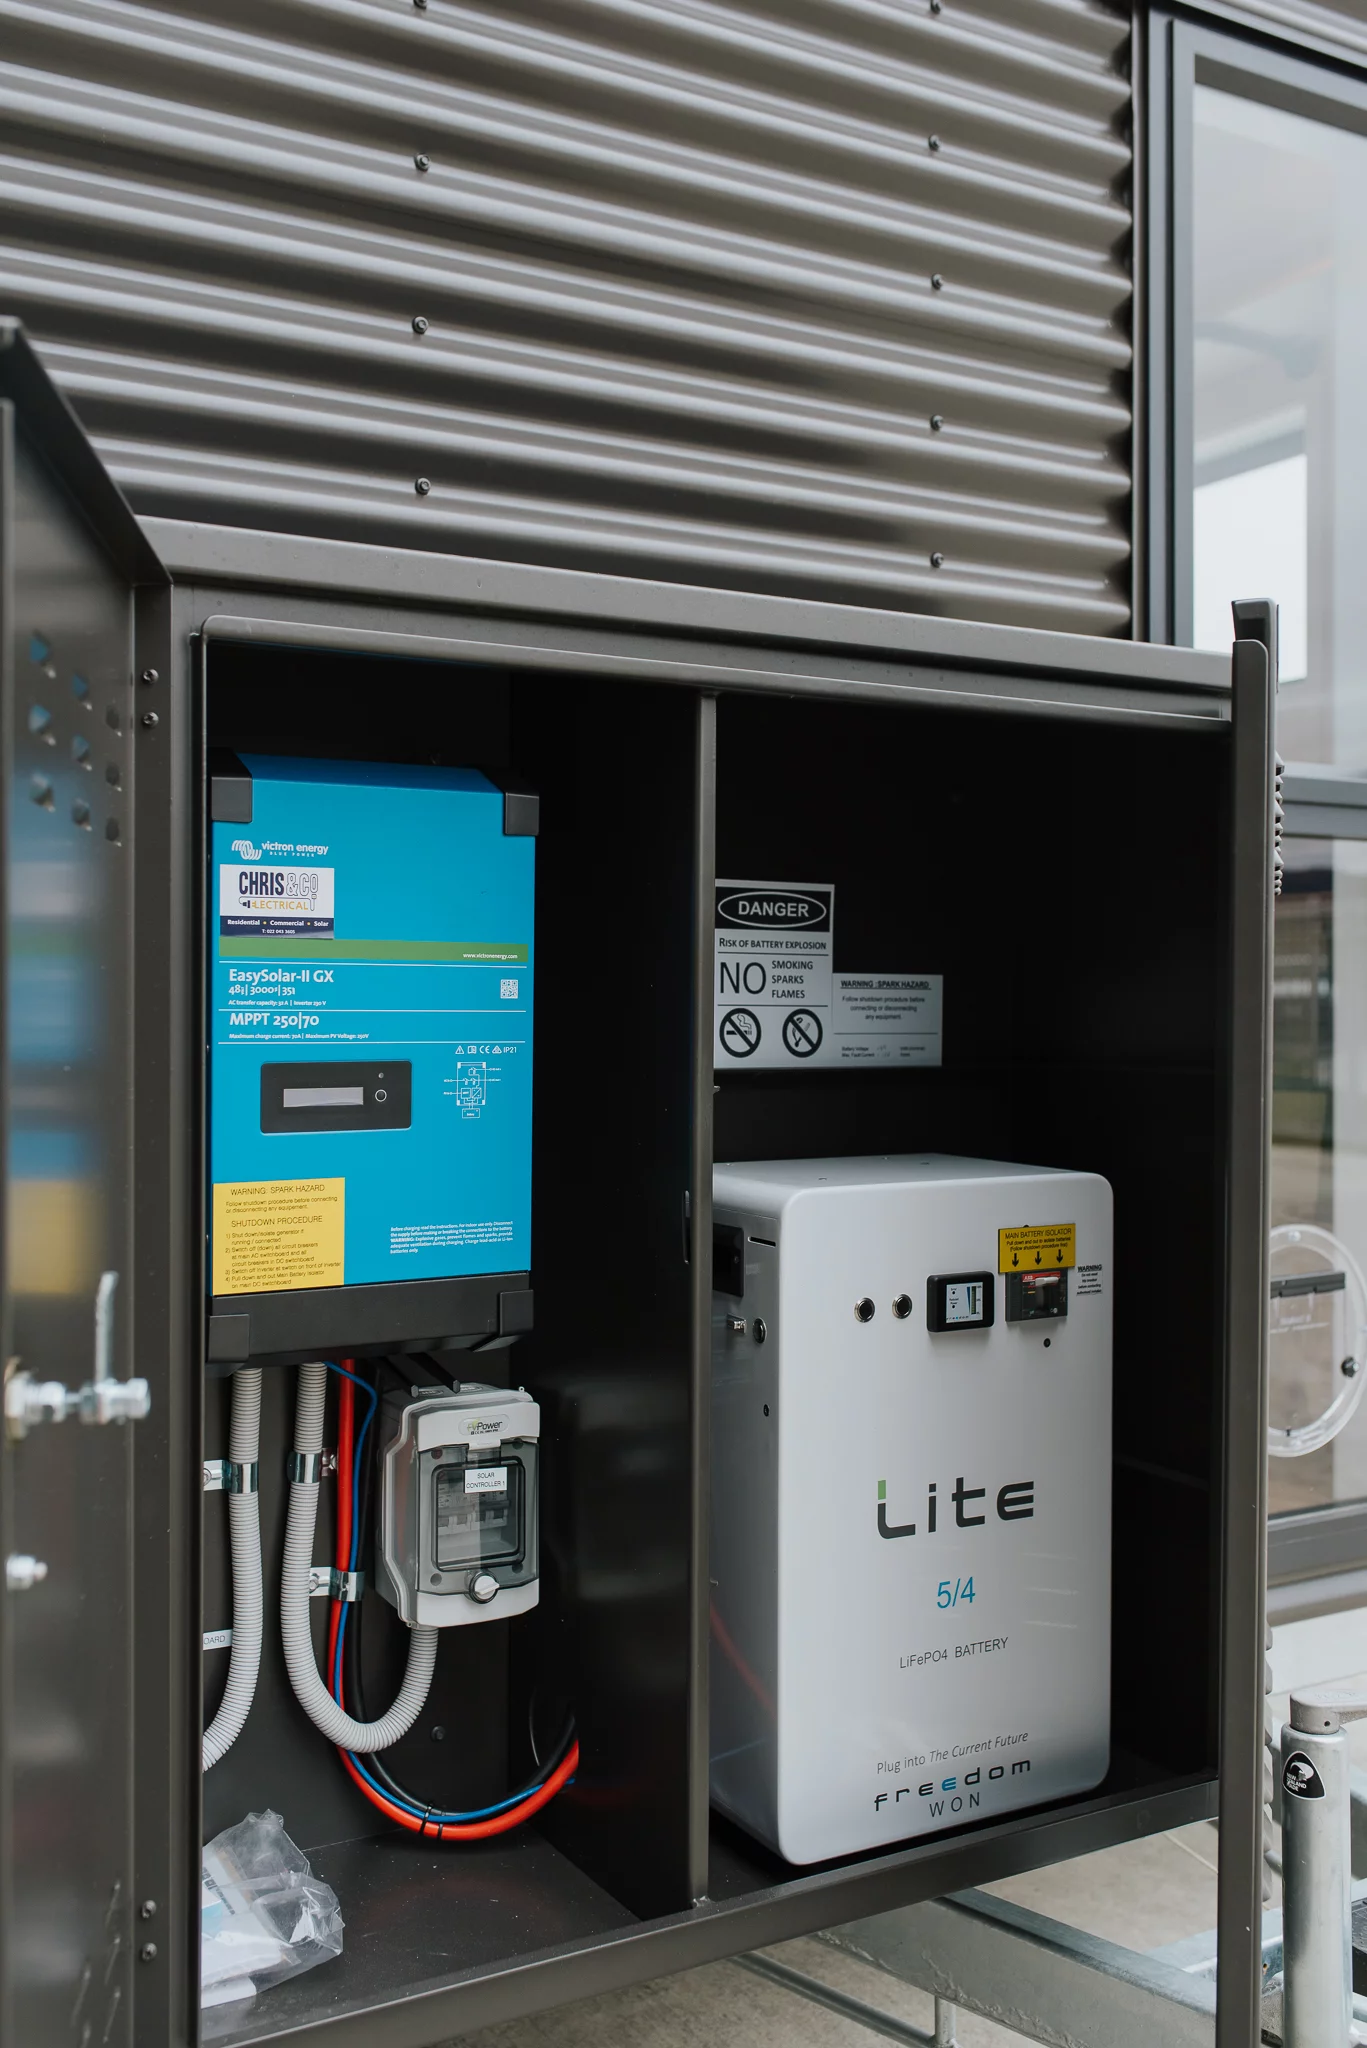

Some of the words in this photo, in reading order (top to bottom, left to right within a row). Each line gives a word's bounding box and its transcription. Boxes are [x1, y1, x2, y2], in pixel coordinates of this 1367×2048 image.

[261, 841, 294, 851] victron
[296, 844, 329, 855] energy
[252, 900, 309, 910] ELECTRICAL
[738, 901, 809, 917] DANGER
[738, 940, 749, 948] OF
[751, 940, 784, 949] BATTERY
[785, 941, 827, 950] EXPLOSION
[462, 952, 518, 960] www.victronenergy.com
[772, 960, 813, 970] SMOKING
[229, 968, 310, 986] EasySolar-II
[313, 970, 334, 983] GX
[720, 961, 767, 995] NO
[772, 975, 804, 984] SPARKS
[771, 989, 805, 999] FLAMES
[229, 1013, 270, 1026] MPPT
[503, 1046, 517, 1054] IP21
[270, 1186, 294, 1194] SPARK
[296, 1184, 325, 1192] HAZARD
[231, 1218, 275, 1228] SHUTDOWN
[277, 1215, 323, 1224] PROCEDURE
[1005, 1232, 1019, 1240] MAIN
[1020, 1230, 1044, 1238] BATTERY
[1045, 1228, 1072, 1237] ISOLATOR
[1077, 1264, 1102, 1272] WARNING
[466, 1480, 502, 1488] CONTROLLER
[878, 1477, 1034, 1539] Lite
[937, 1576, 976, 1609] 5/4
[204, 1635, 226, 1645] OARD
[899, 1649, 948, 1669] LiFePO4
[955, 1637, 1009, 1658] BATTERY
[877, 1760, 900, 1774] Plug
[904, 1755, 926, 1769] into
[930, 1749, 948, 1762] The
[952, 1739, 991, 1758] Current
[994, 1732, 1029, 1748] Future
[929, 1792, 980, 1818] WON
